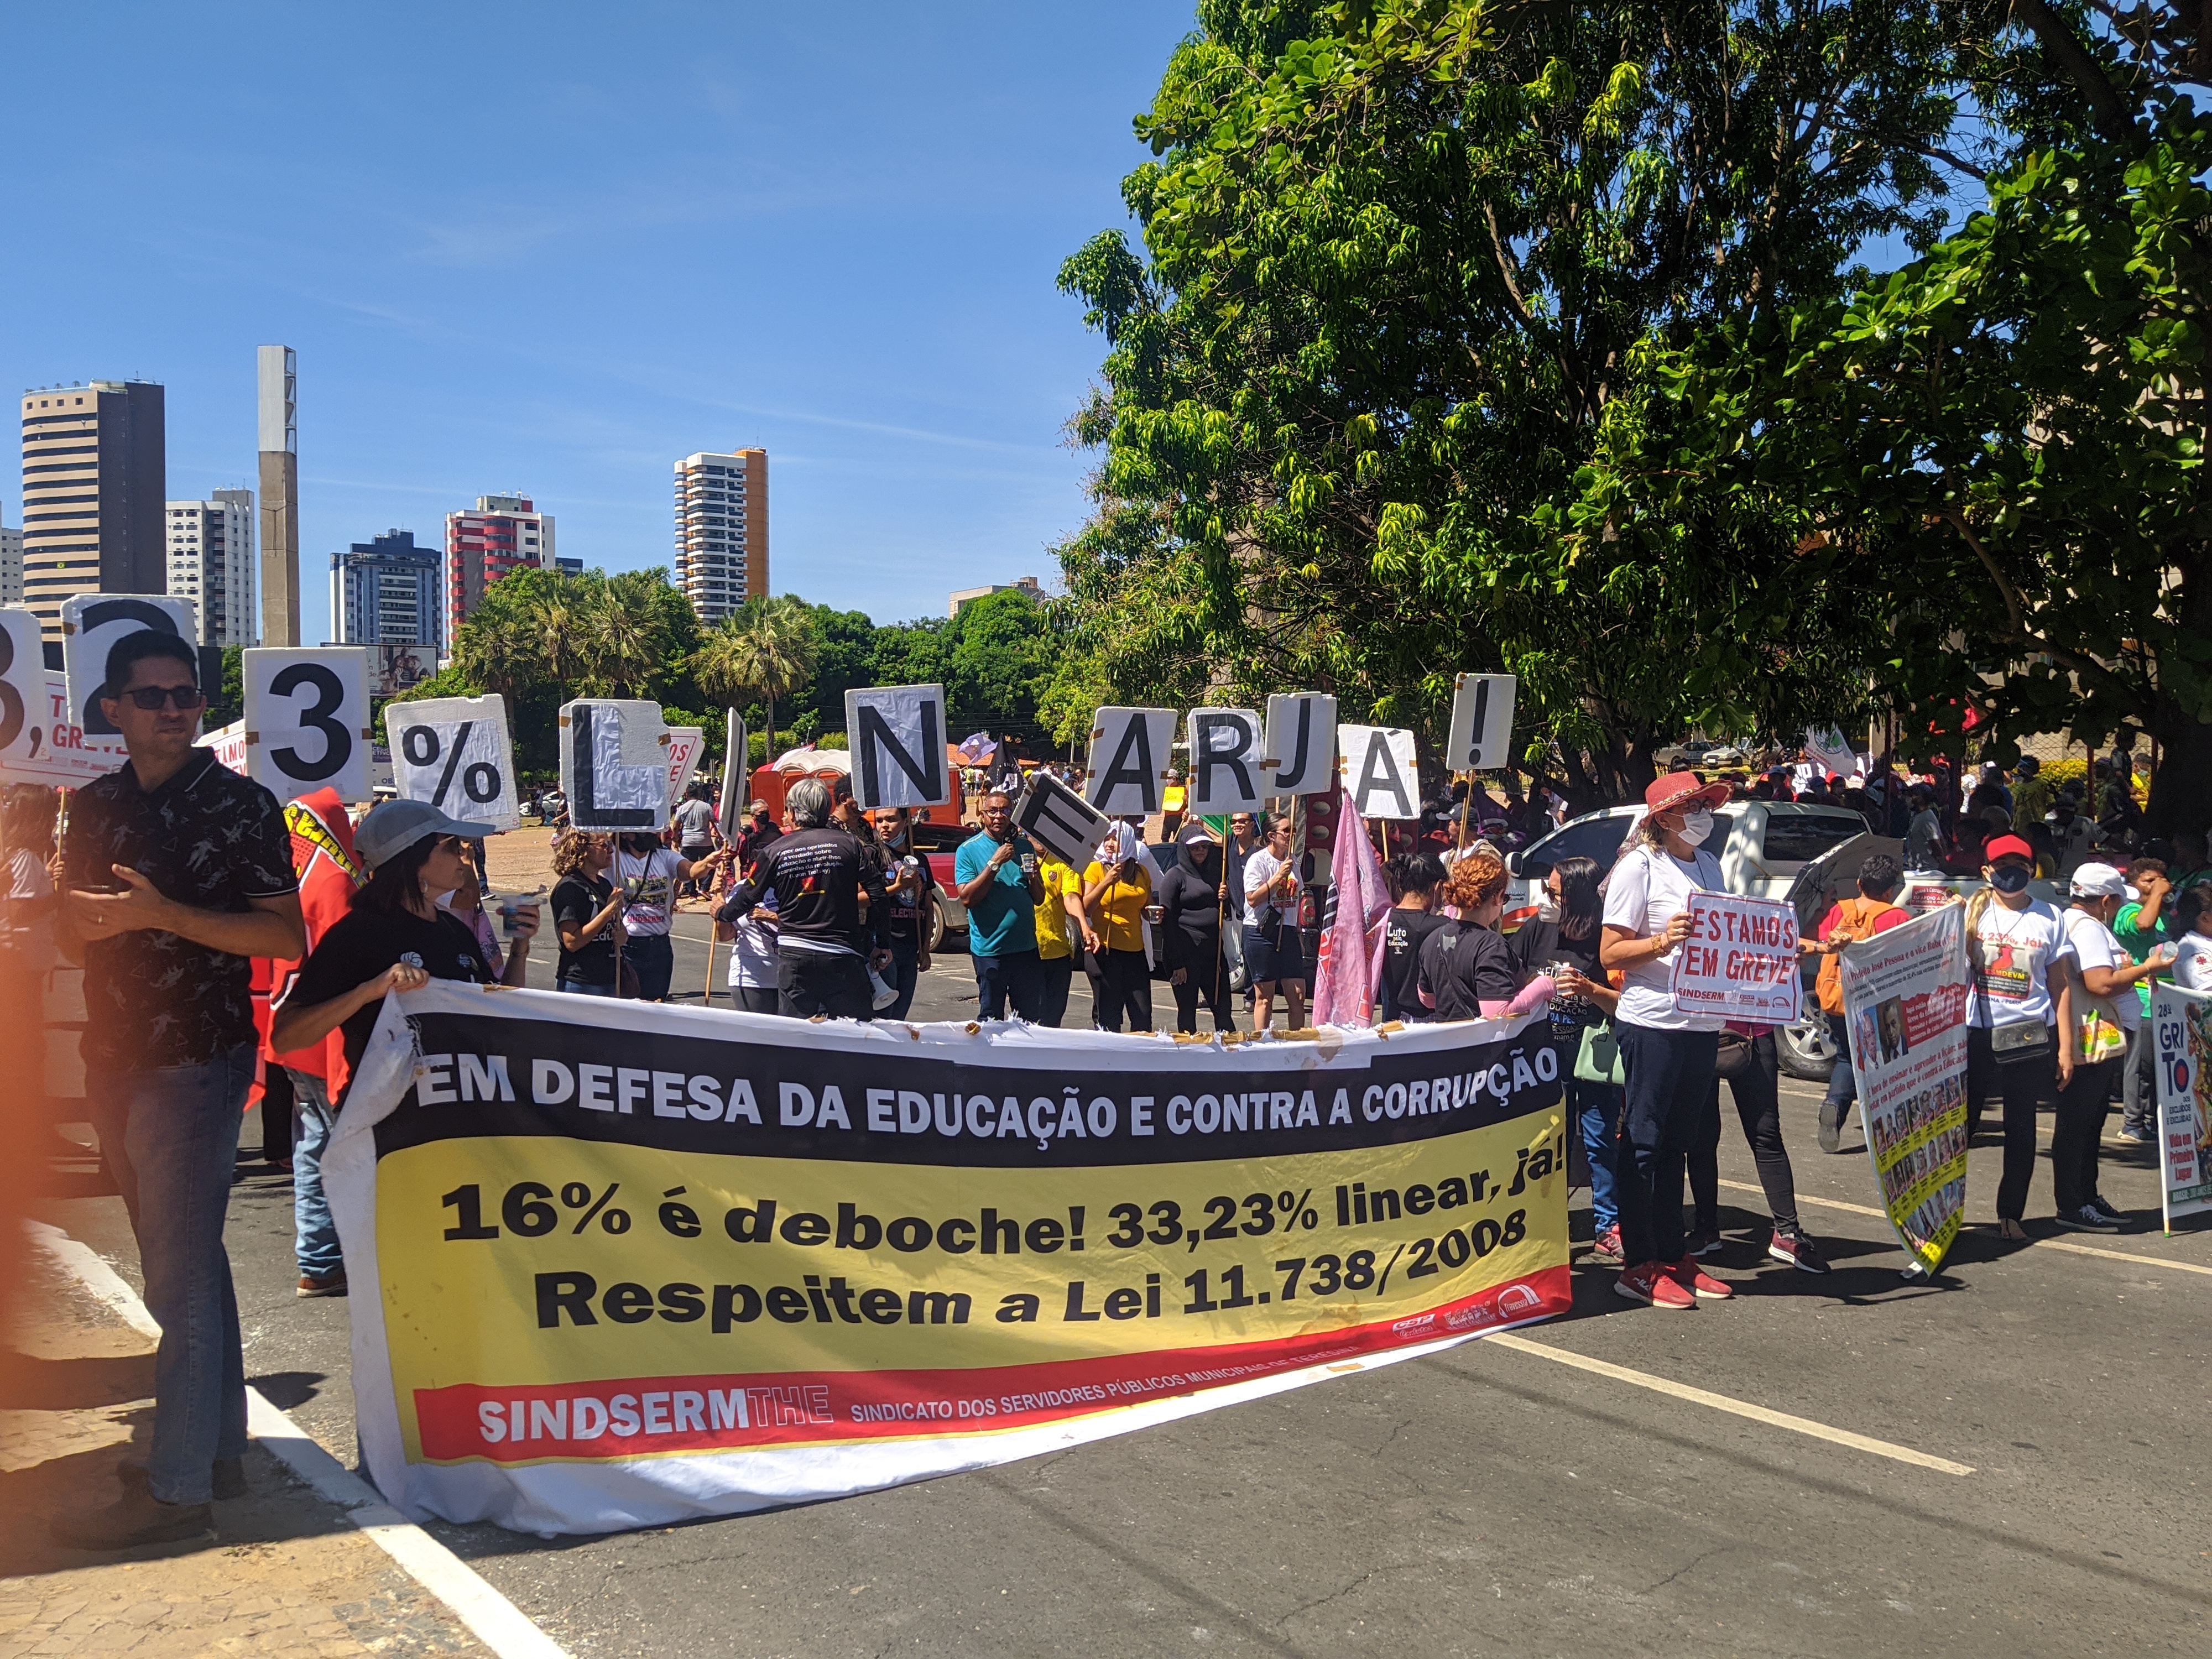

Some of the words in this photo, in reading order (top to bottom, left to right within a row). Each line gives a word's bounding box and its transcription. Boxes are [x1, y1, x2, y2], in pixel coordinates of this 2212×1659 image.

[269, 662, 352, 782] 3
[401, 722, 501, 807] %
[572, 704, 655, 827] L
[858, 700, 942, 808] N
[1092, 712, 1157, 813] A
[1195, 714, 1256, 802] R
[1275, 697, 1311, 789] J
[1468, 679, 1489, 766] !
[788, 851, 813, 859] verdade
[1017, 774, 1099, 866] E
[1387, 921, 1407, 937] Luto
[1684, 945, 1719, 978] EM
[1726, 950, 1793, 985] GREVE
[1690, 907, 1794, 949] ESTAMOS
[1884, 953, 1905, 967] Pessoa
[1915, 944, 1927, 956] vice
[2159, 1021, 2184, 1050] GRI
[2161, 1051, 2190, 1097] TO
[417, 1052, 515, 1108] EM
[531, 1058, 763, 1126] DEFESA
[779, 1082, 853, 1132] DA
[866, 1086, 1118, 1151] EDUCAÇÃO
[1131, 1095, 1155, 1136] E
[1165, 1091, 1318, 1135] CONTRA
[1328, 1088, 1353, 1125] A
[1362, 1045, 1558, 1123] CORRUPÇÃO
[442, 1180, 633, 1241] 16%
[658, 1186, 702, 1238] é
[724, 1198, 1086, 1255] deboche!
[1107, 1187, 1318, 1254] 33,23%
[1334, 1168, 1499, 1228] linear,
[1508, 1134, 1565, 1196] já!
[534, 1270, 971, 1333] Respeitem
[995, 1293, 1040, 1323] a
[1065, 1272, 1162, 1323] Lei
[1183, 1208, 1527, 1314] 11.738/2008
[850, 1389, 956, 1424] SINDICATO
[958, 1397, 997, 1418] DOS
[1000, 1383, 1106, 1416] SERVIDORES
[1105, 1372, 1185, 1397] PÚBLICOS
